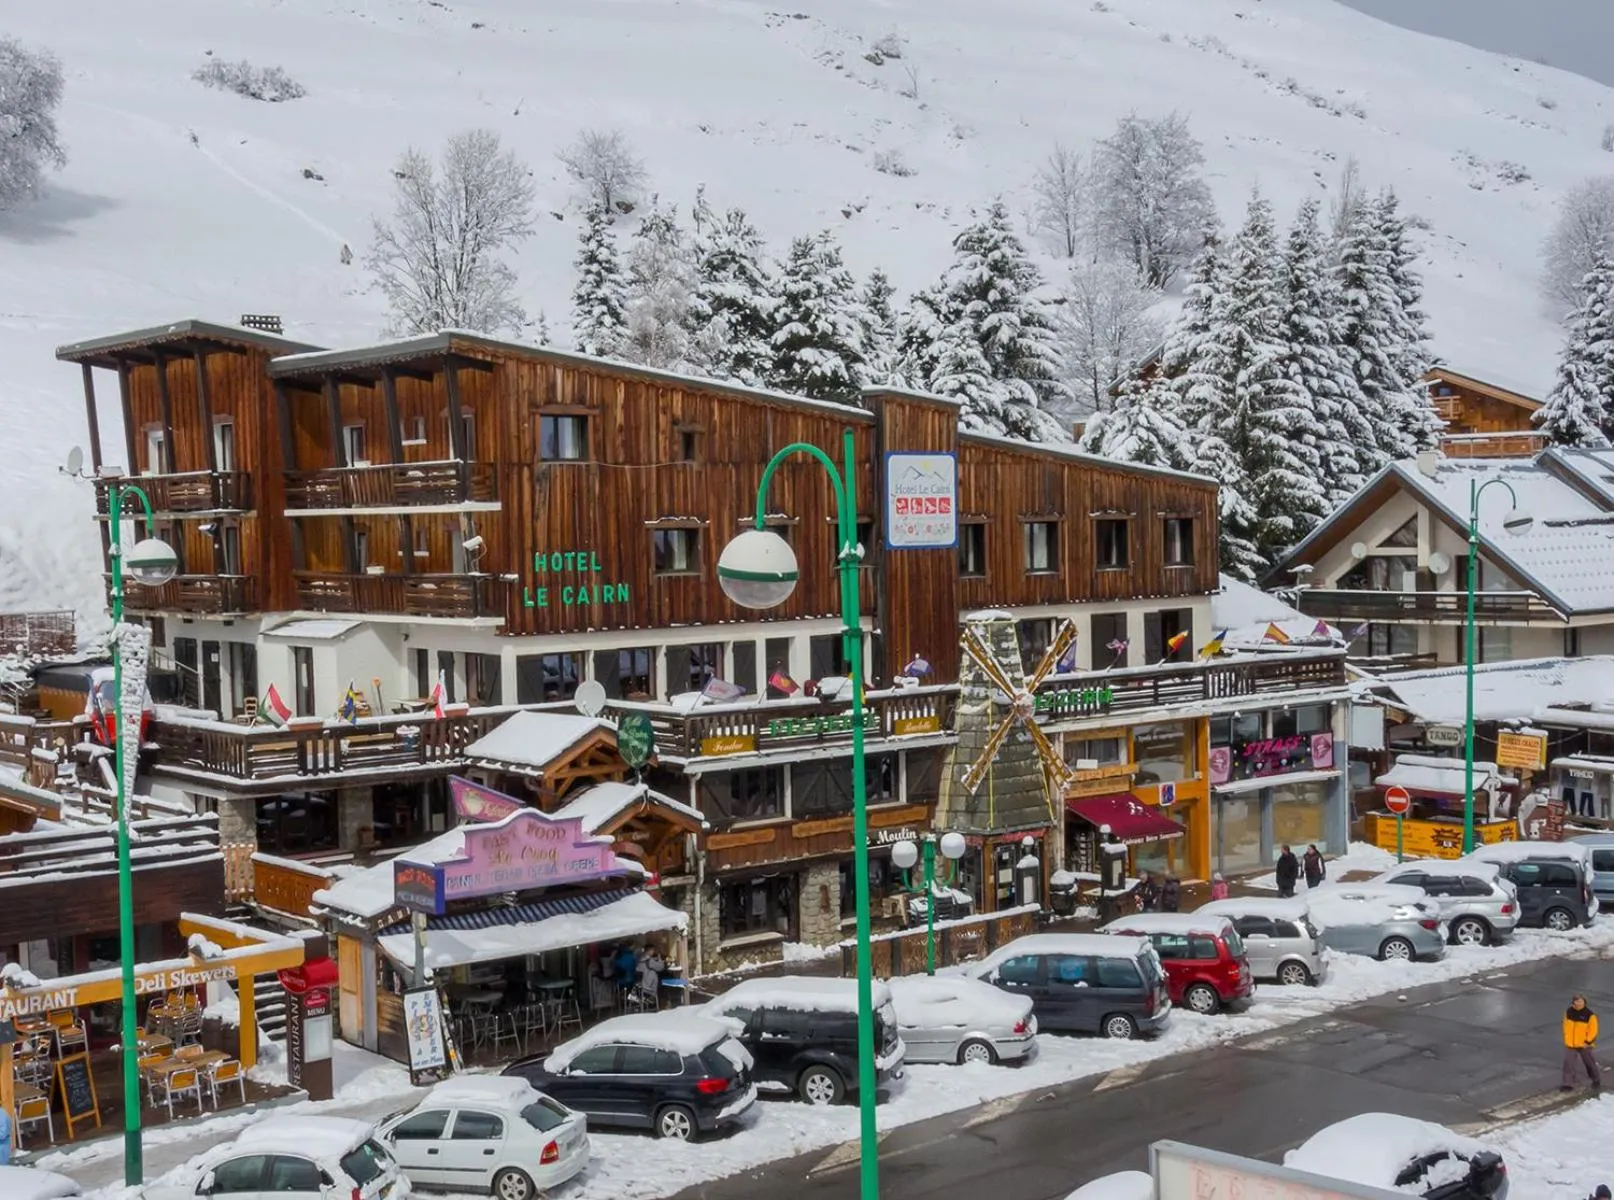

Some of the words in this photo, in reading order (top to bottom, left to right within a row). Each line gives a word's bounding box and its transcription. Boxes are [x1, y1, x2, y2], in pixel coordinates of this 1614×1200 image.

[535, 551, 602, 572] HOTEL
[524, 586, 548, 607] LE
[563, 583, 629, 605] CAIRN
[1035, 687, 1112, 709] IZZERIA
[527, 821, 566, 840] FOOD
[877, 827, 917, 844] Moulin
[171, 966, 236, 988] Skewers
[308, 1007, 325, 1016] MENU
